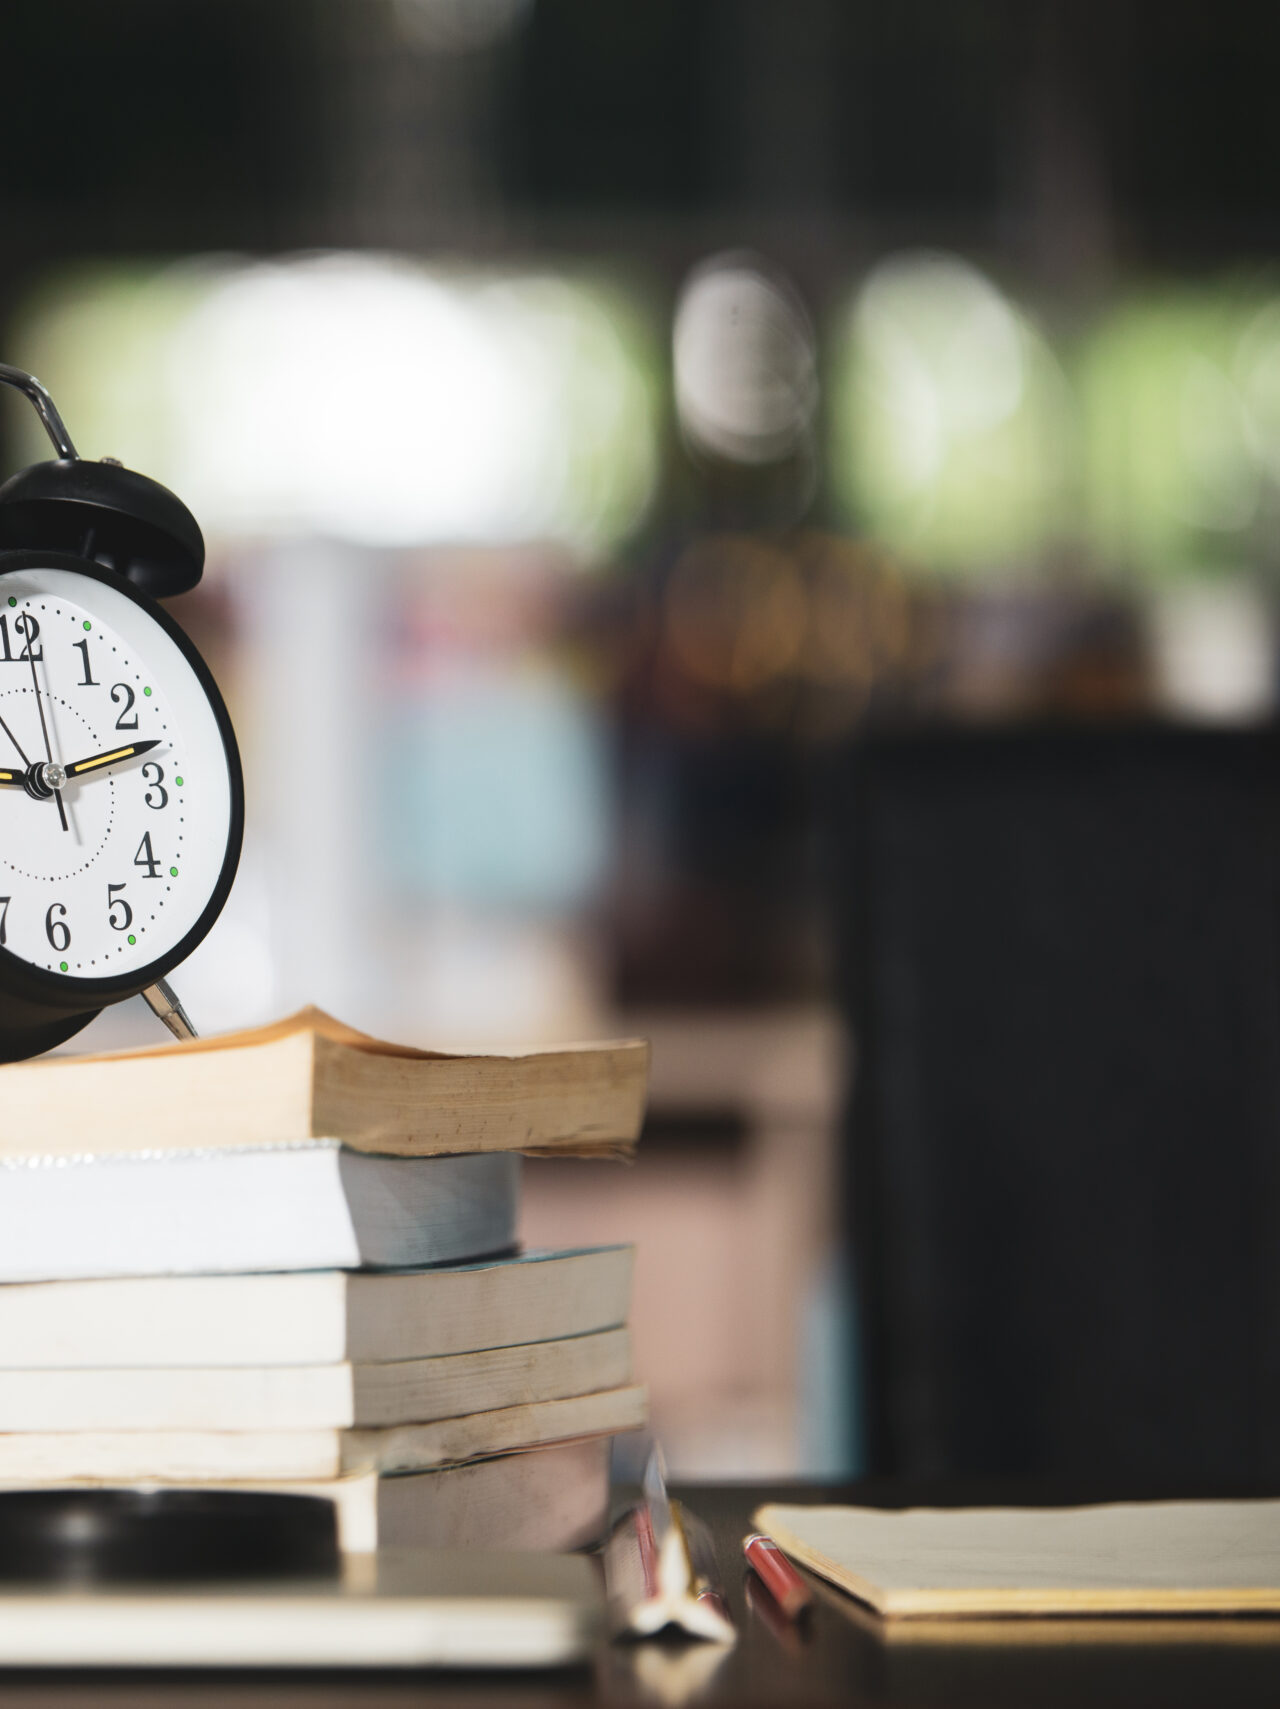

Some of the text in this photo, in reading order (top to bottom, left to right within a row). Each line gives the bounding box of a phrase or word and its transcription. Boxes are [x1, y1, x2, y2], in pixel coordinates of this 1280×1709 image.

[72, 638, 100, 686] 1
[110, 683, 139, 730] 2
[141, 762, 169, 809] 3
[133, 831, 163, 878] 4
[45, 903, 71, 952] 6
[107, 883, 133, 931] 5
